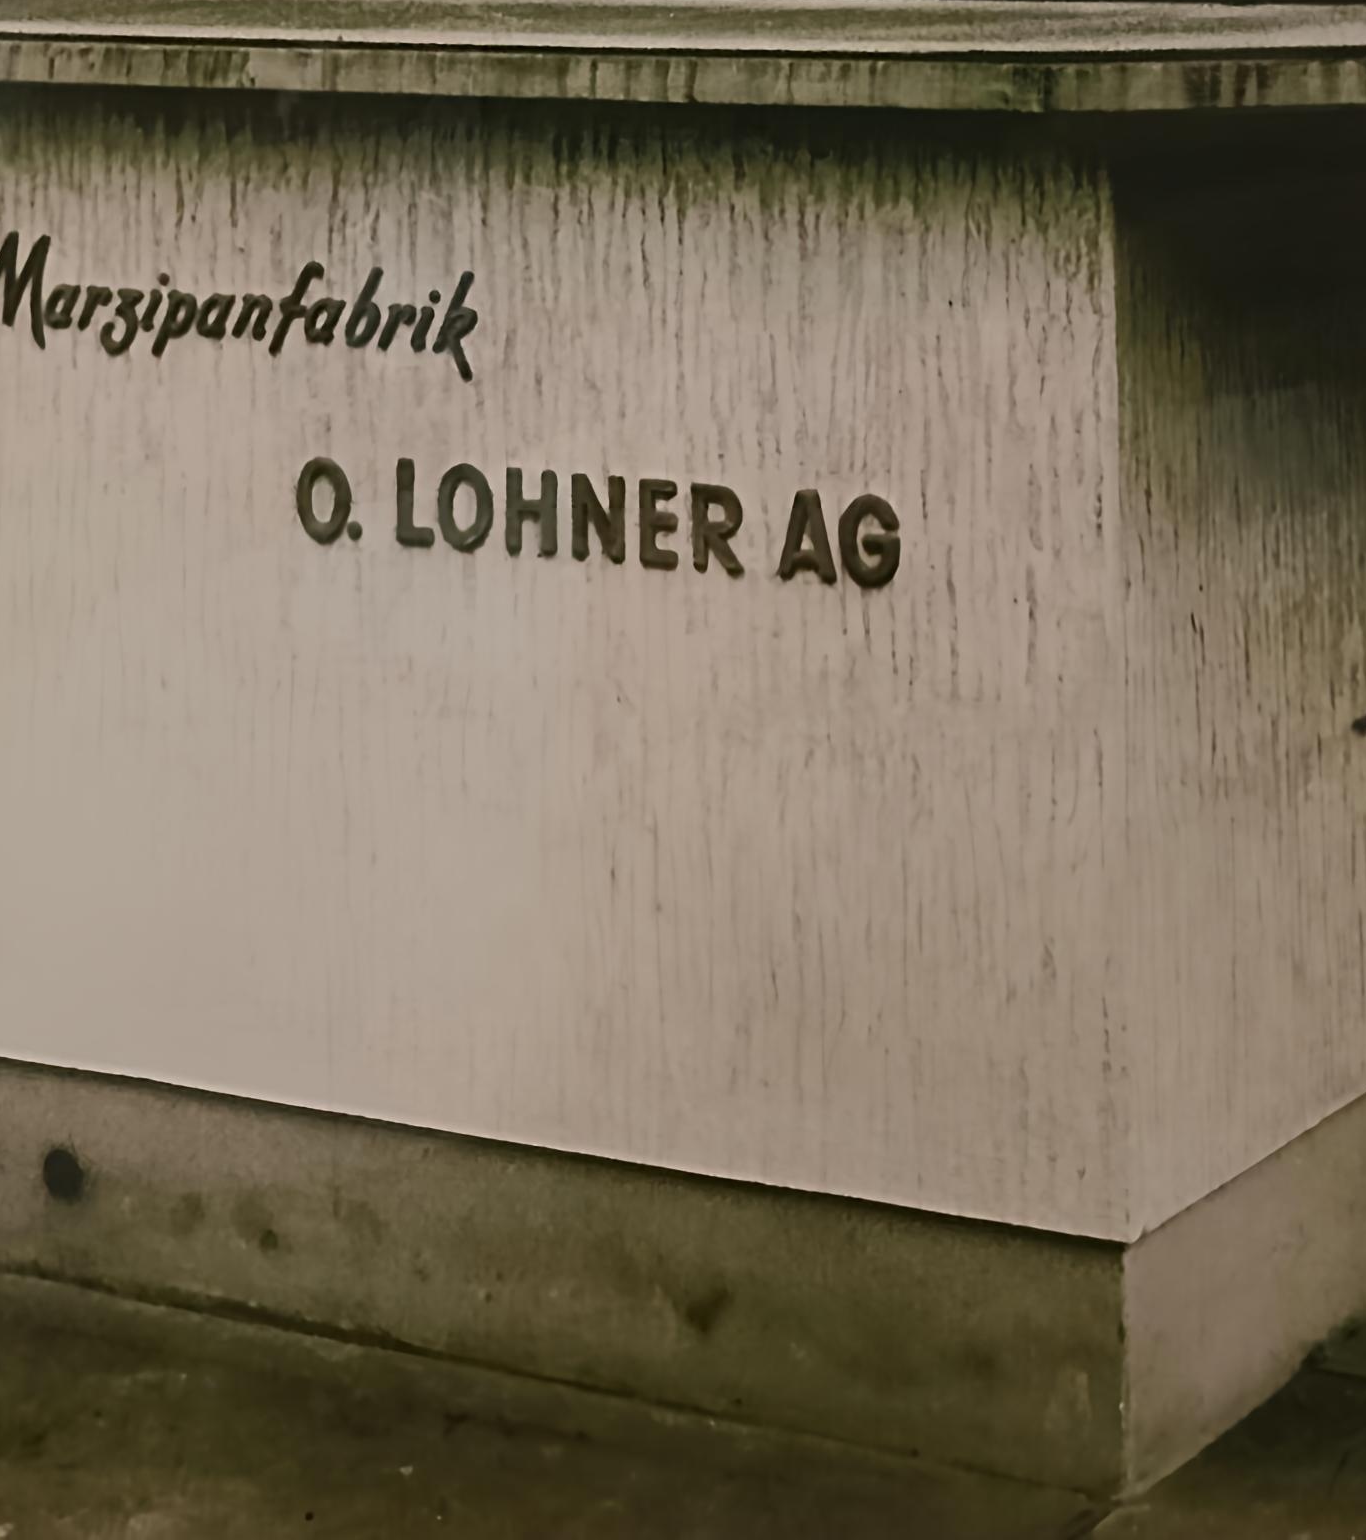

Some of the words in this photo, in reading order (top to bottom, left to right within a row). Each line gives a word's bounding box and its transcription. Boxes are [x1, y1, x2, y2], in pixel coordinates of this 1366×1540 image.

[295, 457, 364, 546] O.
[395, 457, 745, 578] LOHNER
[775, 489, 902, 592] AG
